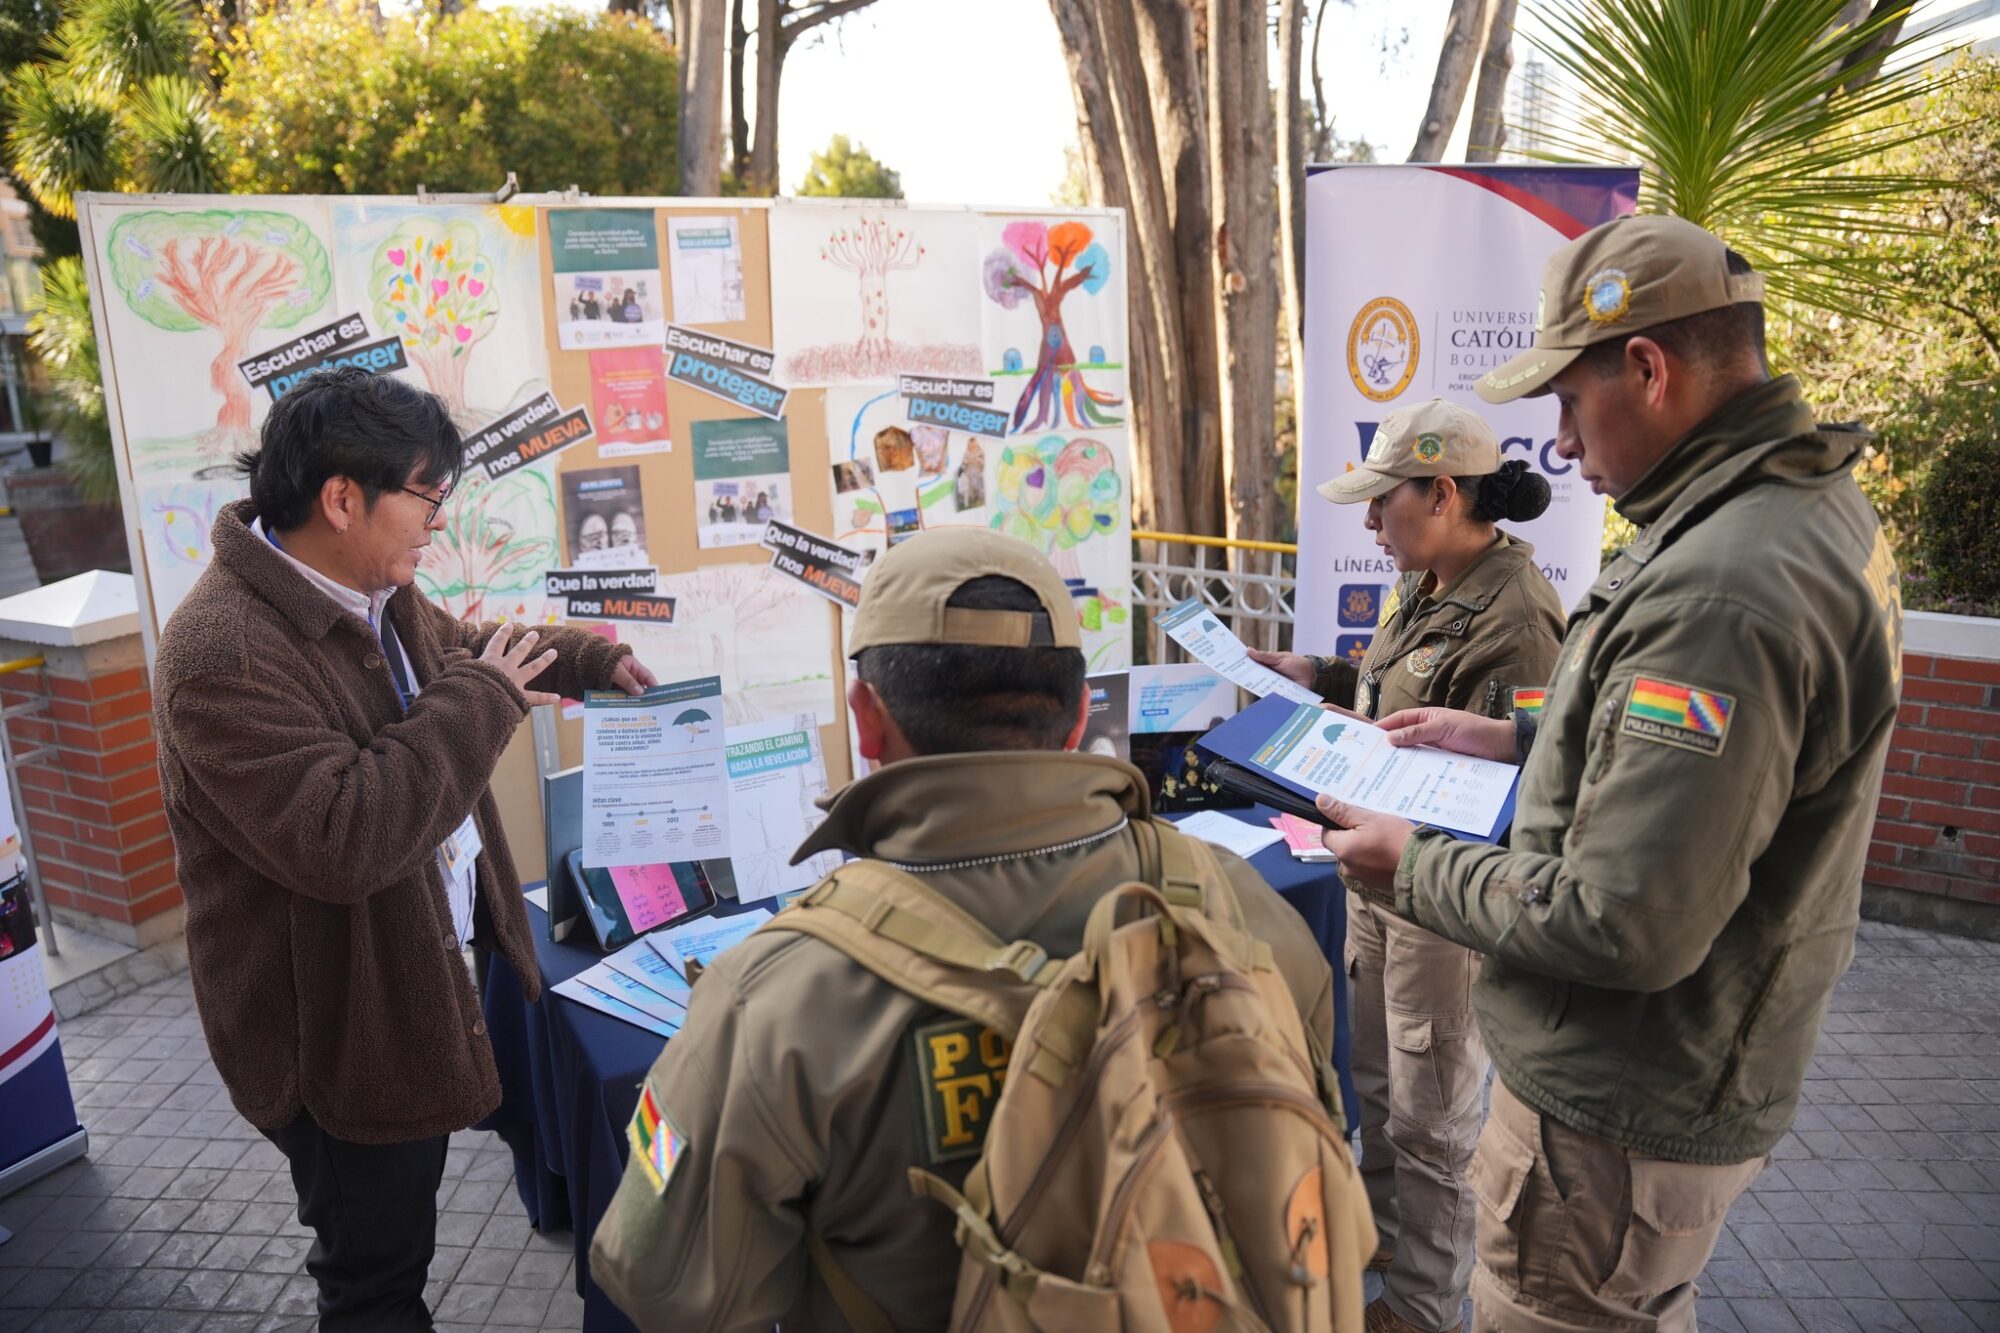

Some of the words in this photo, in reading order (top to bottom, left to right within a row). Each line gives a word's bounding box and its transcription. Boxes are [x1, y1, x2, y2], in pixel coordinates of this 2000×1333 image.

[1453, 311, 1535, 324] UNIVERSI
[1451, 326, 1535, 348] CATÓLI
[241, 328, 336, 383] Escuchar
[339, 318, 365, 339] es
[667, 329, 750, 364] Escuchar
[750, 353, 771, 370] es
[1451, 354, 1512, 366] BOLIV
[672, 353, 783, 409] proteger
[901, 379, 974, 396] Escuchar
[974, 384, 993, 398] es
[483, 431, 503, 448] la
[501, 396, 556, 438] verdad
[911, 398, 1007, 432] proteger
[488, 451, 521, 474] nos
[518, 417, 588, 459] MUEVA
[765, 525, 796, 547] Que
[795, 537, 810, 552] la
[810, 544, 859, 569] verdad
[1334, 555, 1394, 572] LÍNEAS
[547, 577, 581, 594] Que
[582, 575, 597, 590] la
[599, 572, 655, 590] verdad
[777, 555, 805, 575] nos
[803, 564, 859, 603] MUEVA
[570, 600, 602, 614] nos
[604, 599, 671, 618] MUEVA
[726, 740, 764, 757] TRAZANDO
[765, 740, 775, 750] EL
[775, 733, 804, 748] CAMINO
[730, 759, 753, 773] HACIA
[754, 758, 764, 768] LA
